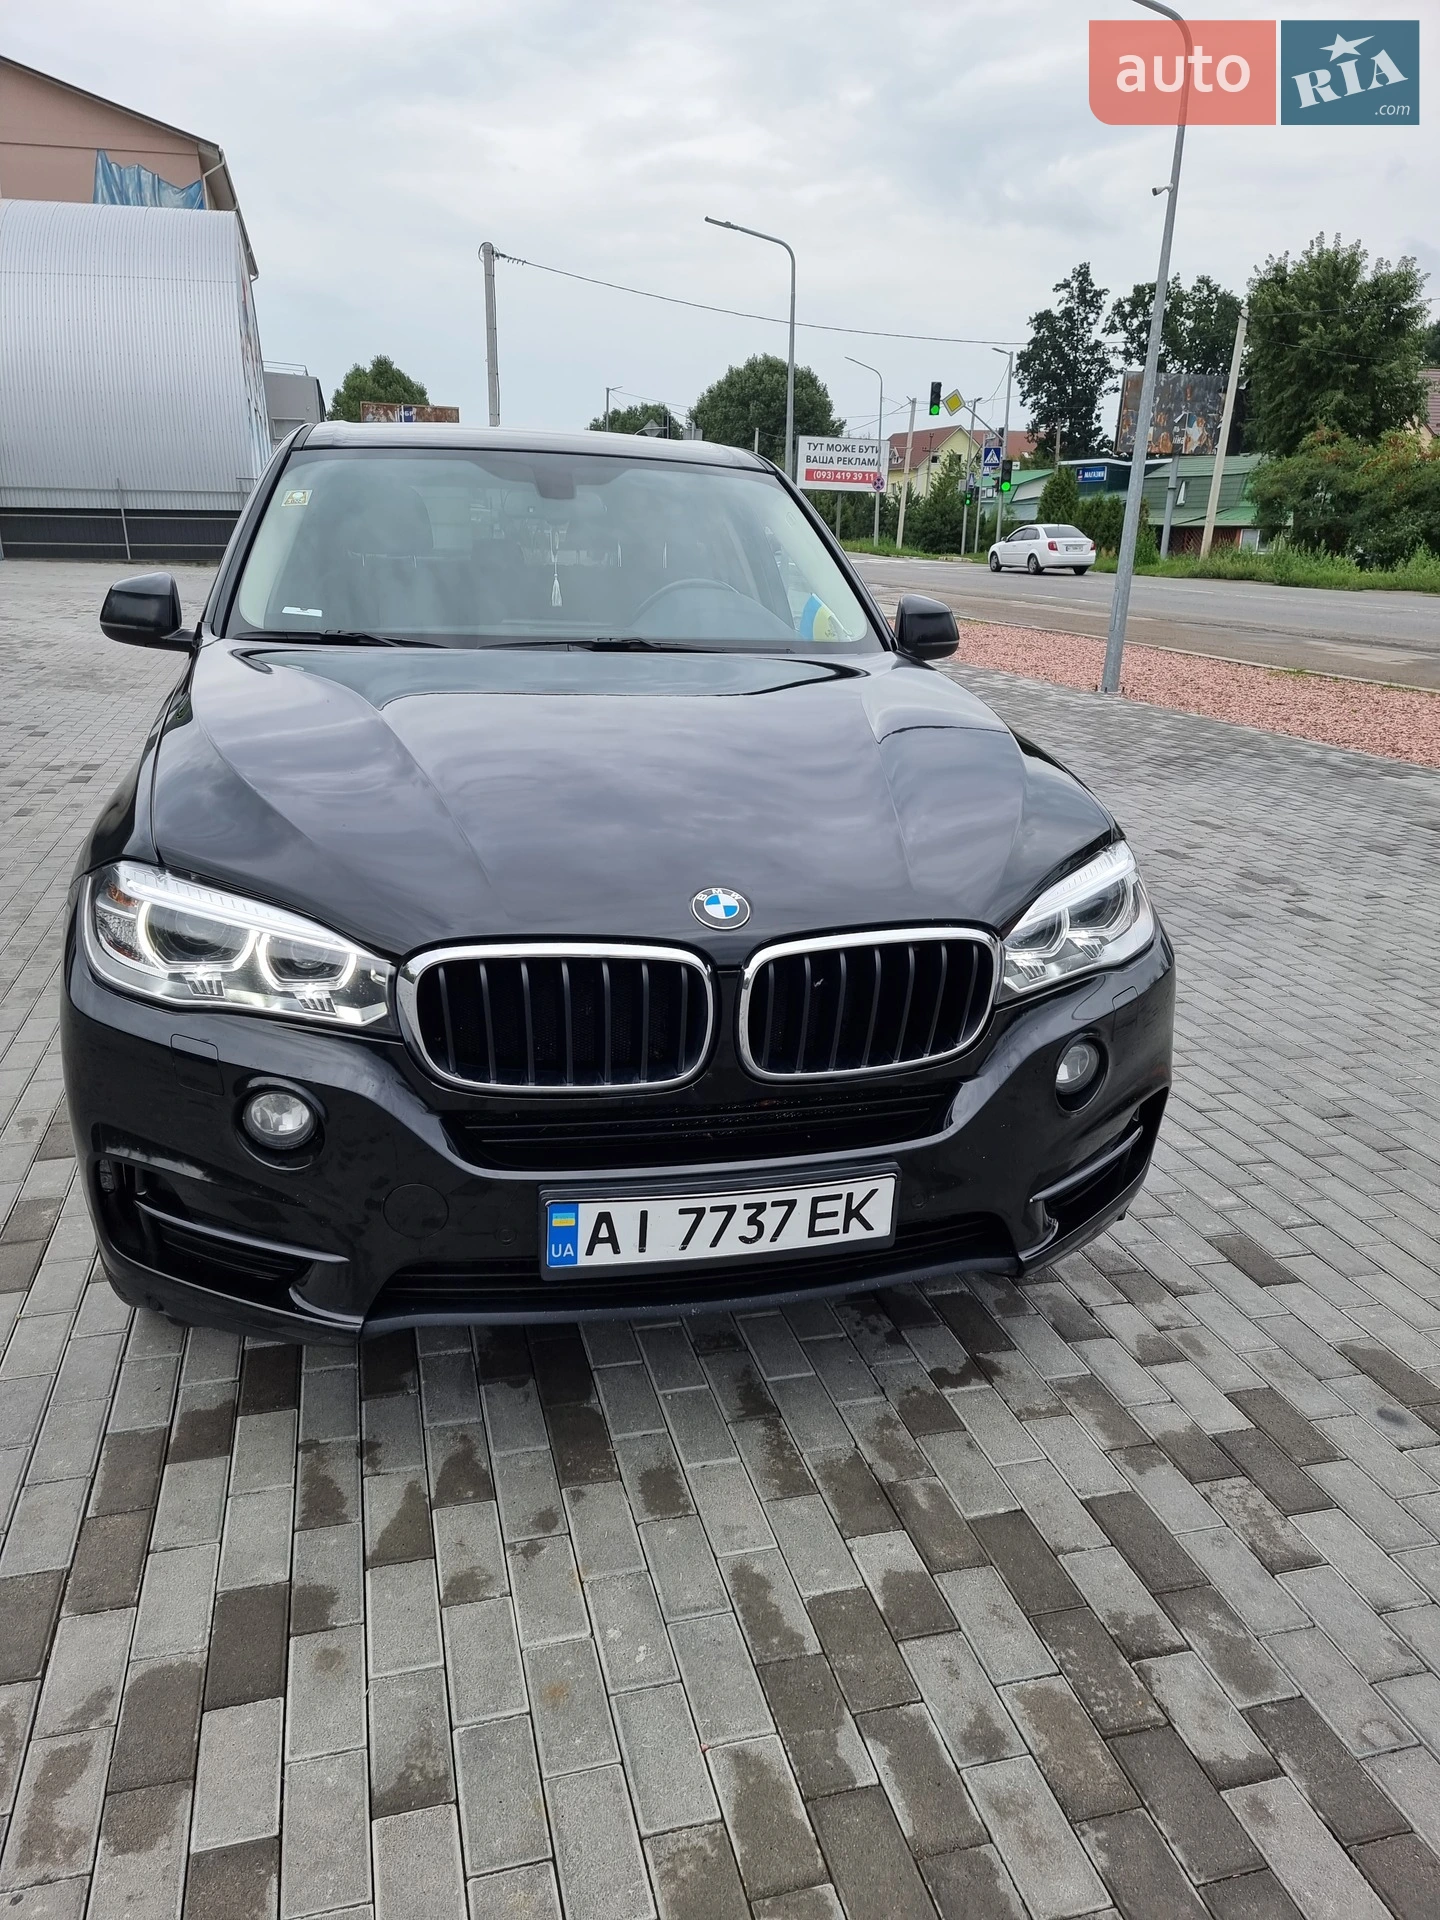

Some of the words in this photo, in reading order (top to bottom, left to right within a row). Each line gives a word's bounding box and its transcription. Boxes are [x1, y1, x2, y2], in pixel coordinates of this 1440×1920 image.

[807, 442, 824, 451] ТУТ
[826, 444, 856, 453] МОЖЕ
[806, 455, 834, 465] ВАША
[836, 457, 881, 467] РЕКЛАМА
[813, 470, 834, 480] (093)
[836, 472, 851, 481] 419
[852, 473, 863, 481] 39
[585, 1210, 649, 1257] AI
[678, 1199, 798, 1251] 7737
[807, 1188, 879, 1238] EK
[551, 1243, 575, 1258] UA
